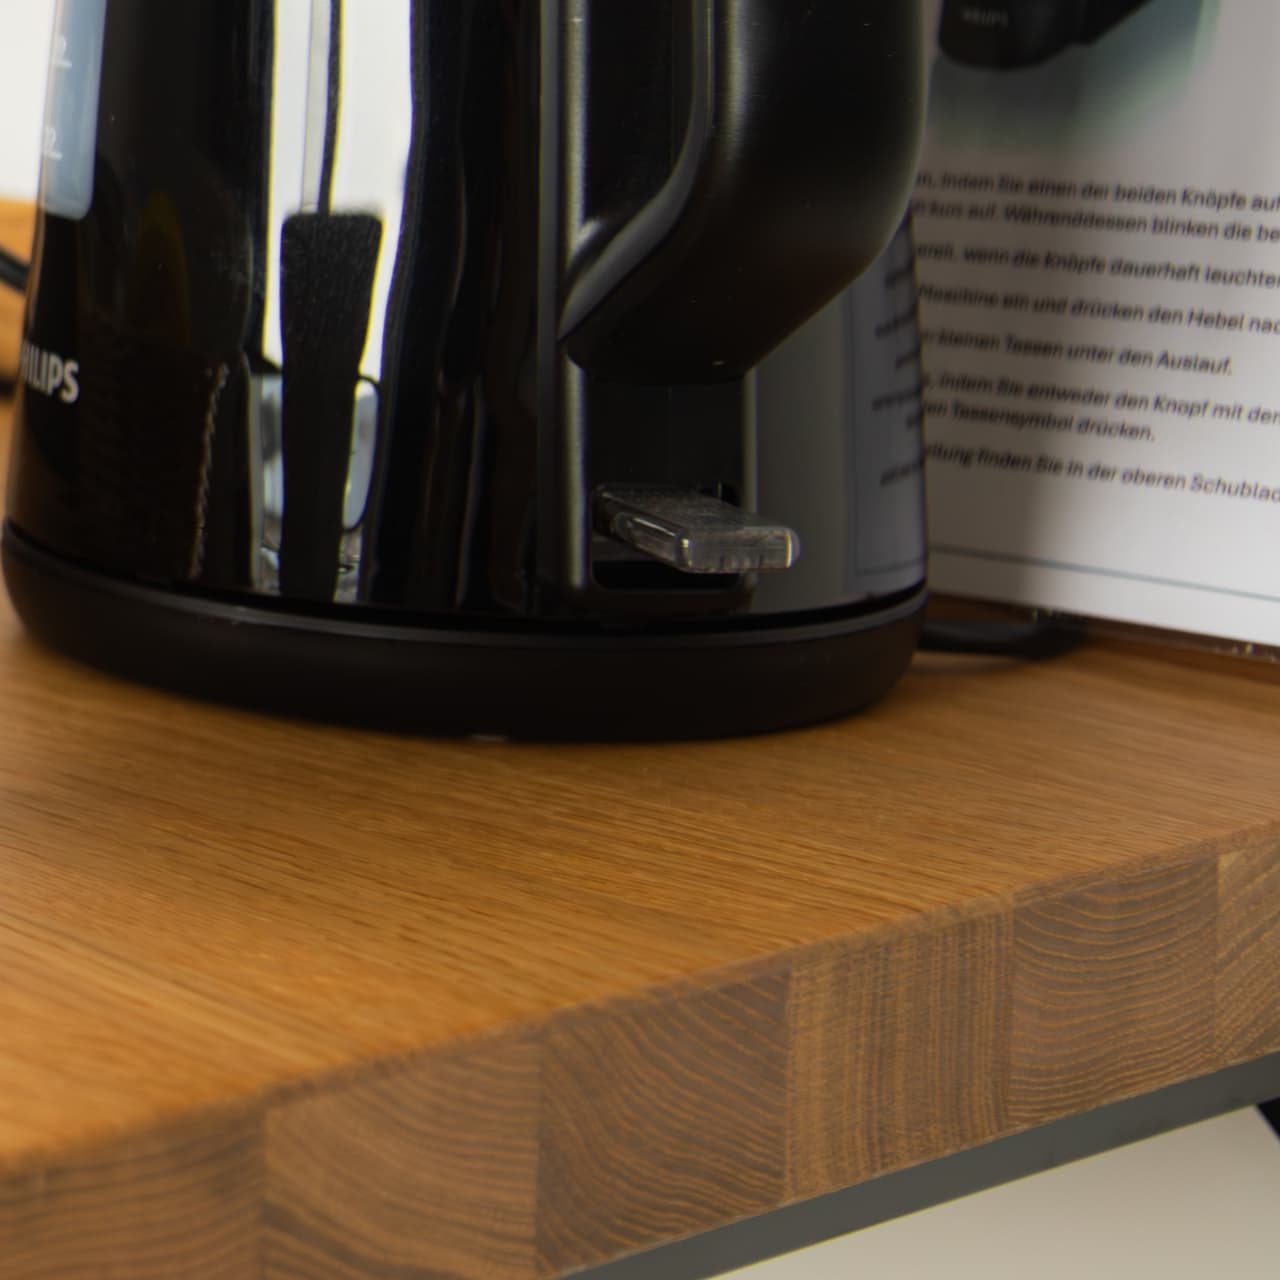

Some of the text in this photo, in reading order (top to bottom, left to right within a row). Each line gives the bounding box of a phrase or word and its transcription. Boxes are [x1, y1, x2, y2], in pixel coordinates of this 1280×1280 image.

[1027, 176, 1077, 199] einen
[1081, 179, 1110, 201] der
[1114, 183, 1177, 206] beiden
[1181, 187, 1247, 215] Knöpfe
[1004, 202, 1148, 233] Währenddessen
[1150, 214, 1219, 240] blinken
[1223, 219, 1253, 242] die
[963, 247, 1009, 266] wenn
[1012, 248, 1040, 269] die
[1044, 250, 1106, 276] Knöpfe
[1109, 257, 1201, 283] dauerhaft
[1001, 289, 1029, 310] ein
[1032, 293, 1068, 315] und
[1071, 297, 1144, 322] drücken
[1148, 303, 1183, 326] den
[1188, 306, 1245, 332] Hebel
[1066, 340, 1114, 364] unter
[1118, 347, 1153, 368] den
[1156, 349, 1233, 377] Auslauf.
[1027, 380, 1110, 408] entweder
[1114, 390, 1149, 412] den
[1152, 392, 1211, 420] Knopf
[1211, 401, 1244, 423] mit
[1076, 418, 1156, 443] drücken.
[1035, 452, 1064, 475] Sie
[1067, 457, 1084, 478] in
[1088, 459, 1118, 483] der
[1121, 466, 1187, 493] oberen
